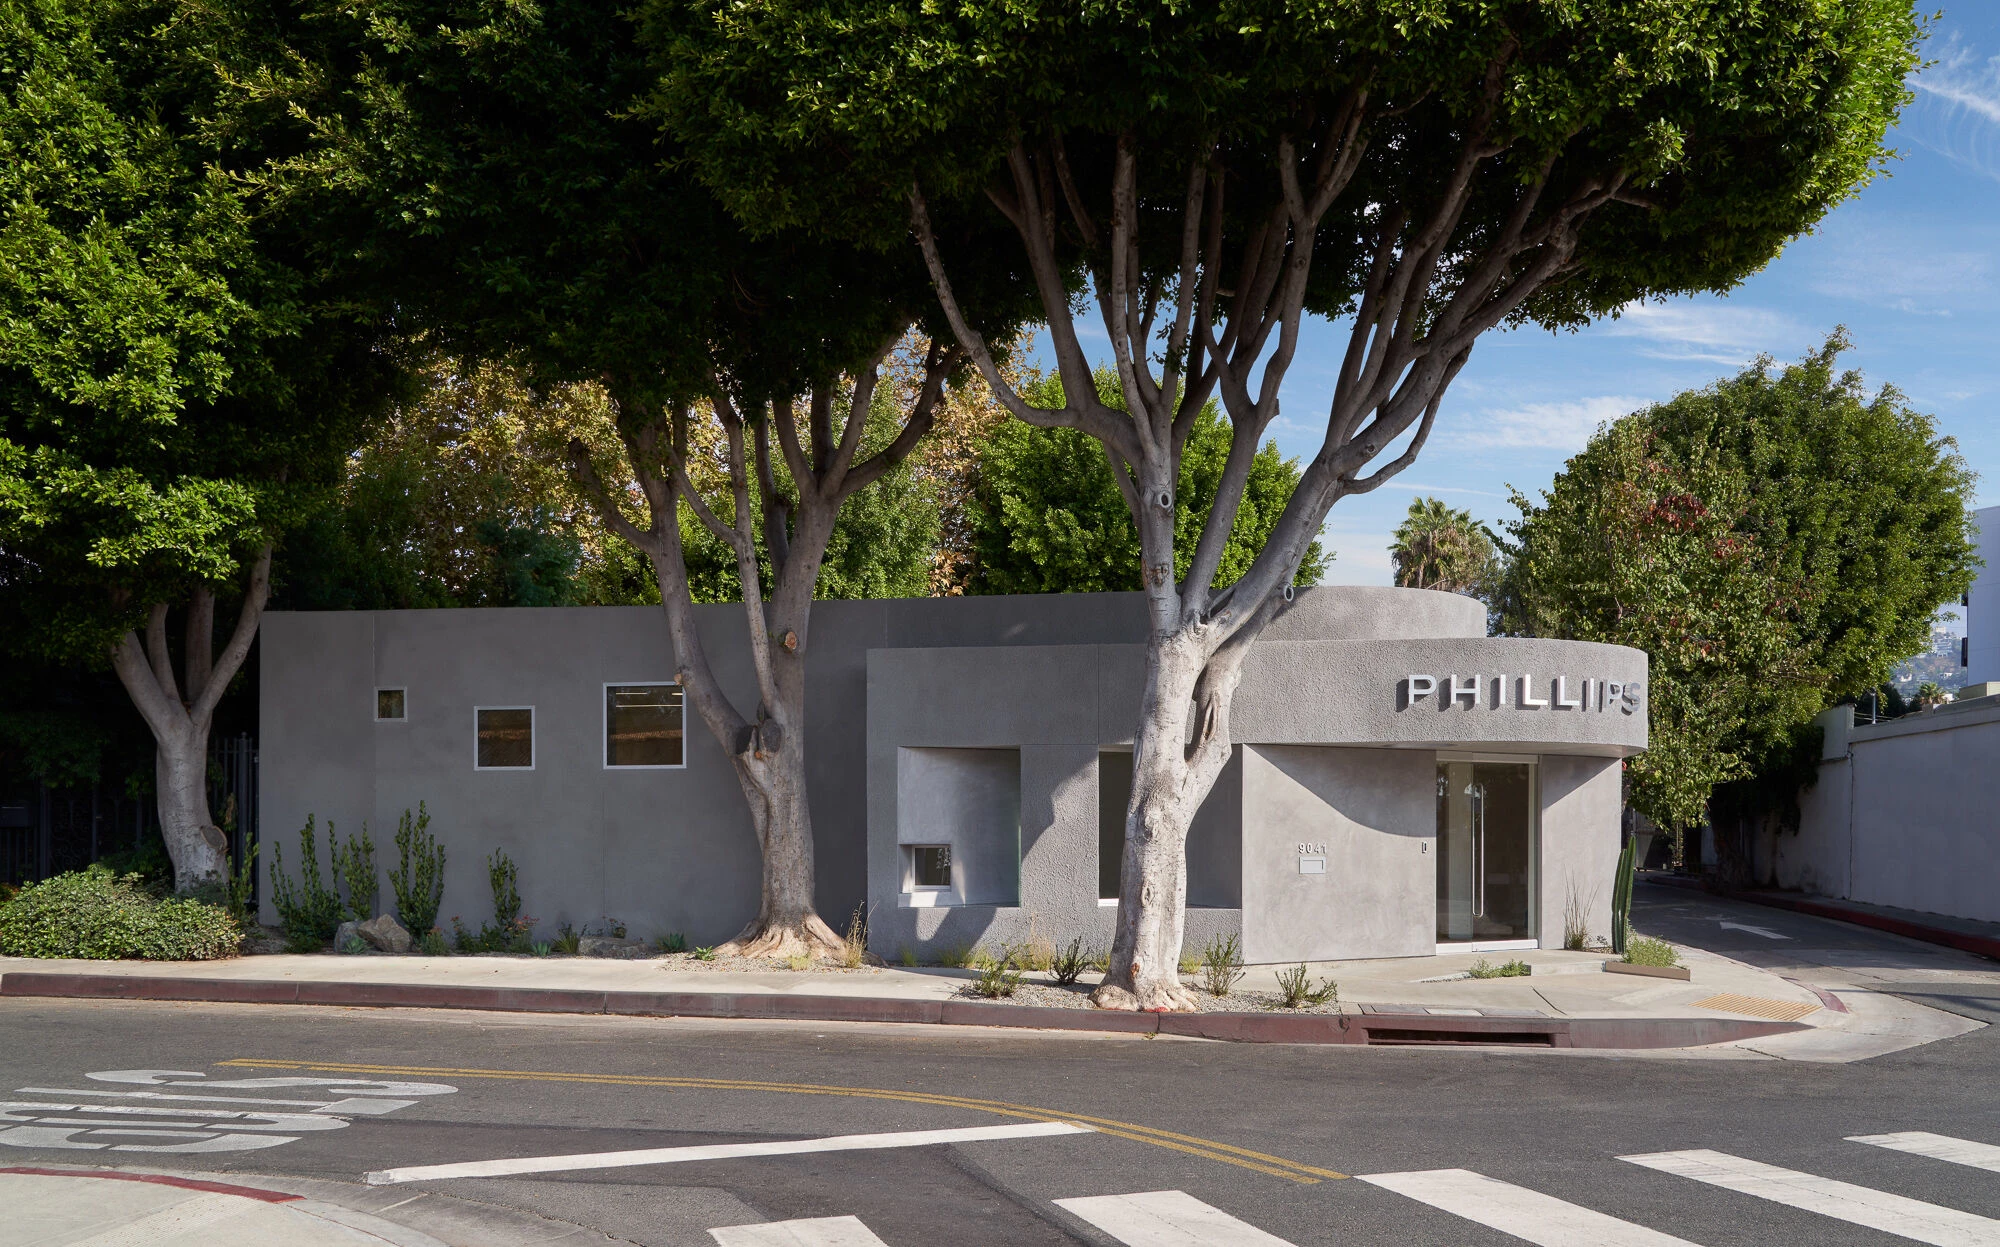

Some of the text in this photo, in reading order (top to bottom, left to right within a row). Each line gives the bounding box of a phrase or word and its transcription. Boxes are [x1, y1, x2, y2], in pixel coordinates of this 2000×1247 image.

[1407, 674, 1641, 712] PHILLIPS
[1298, 842, 1327, 854] 9041
[0, 1069, 459, 1153] STOP
